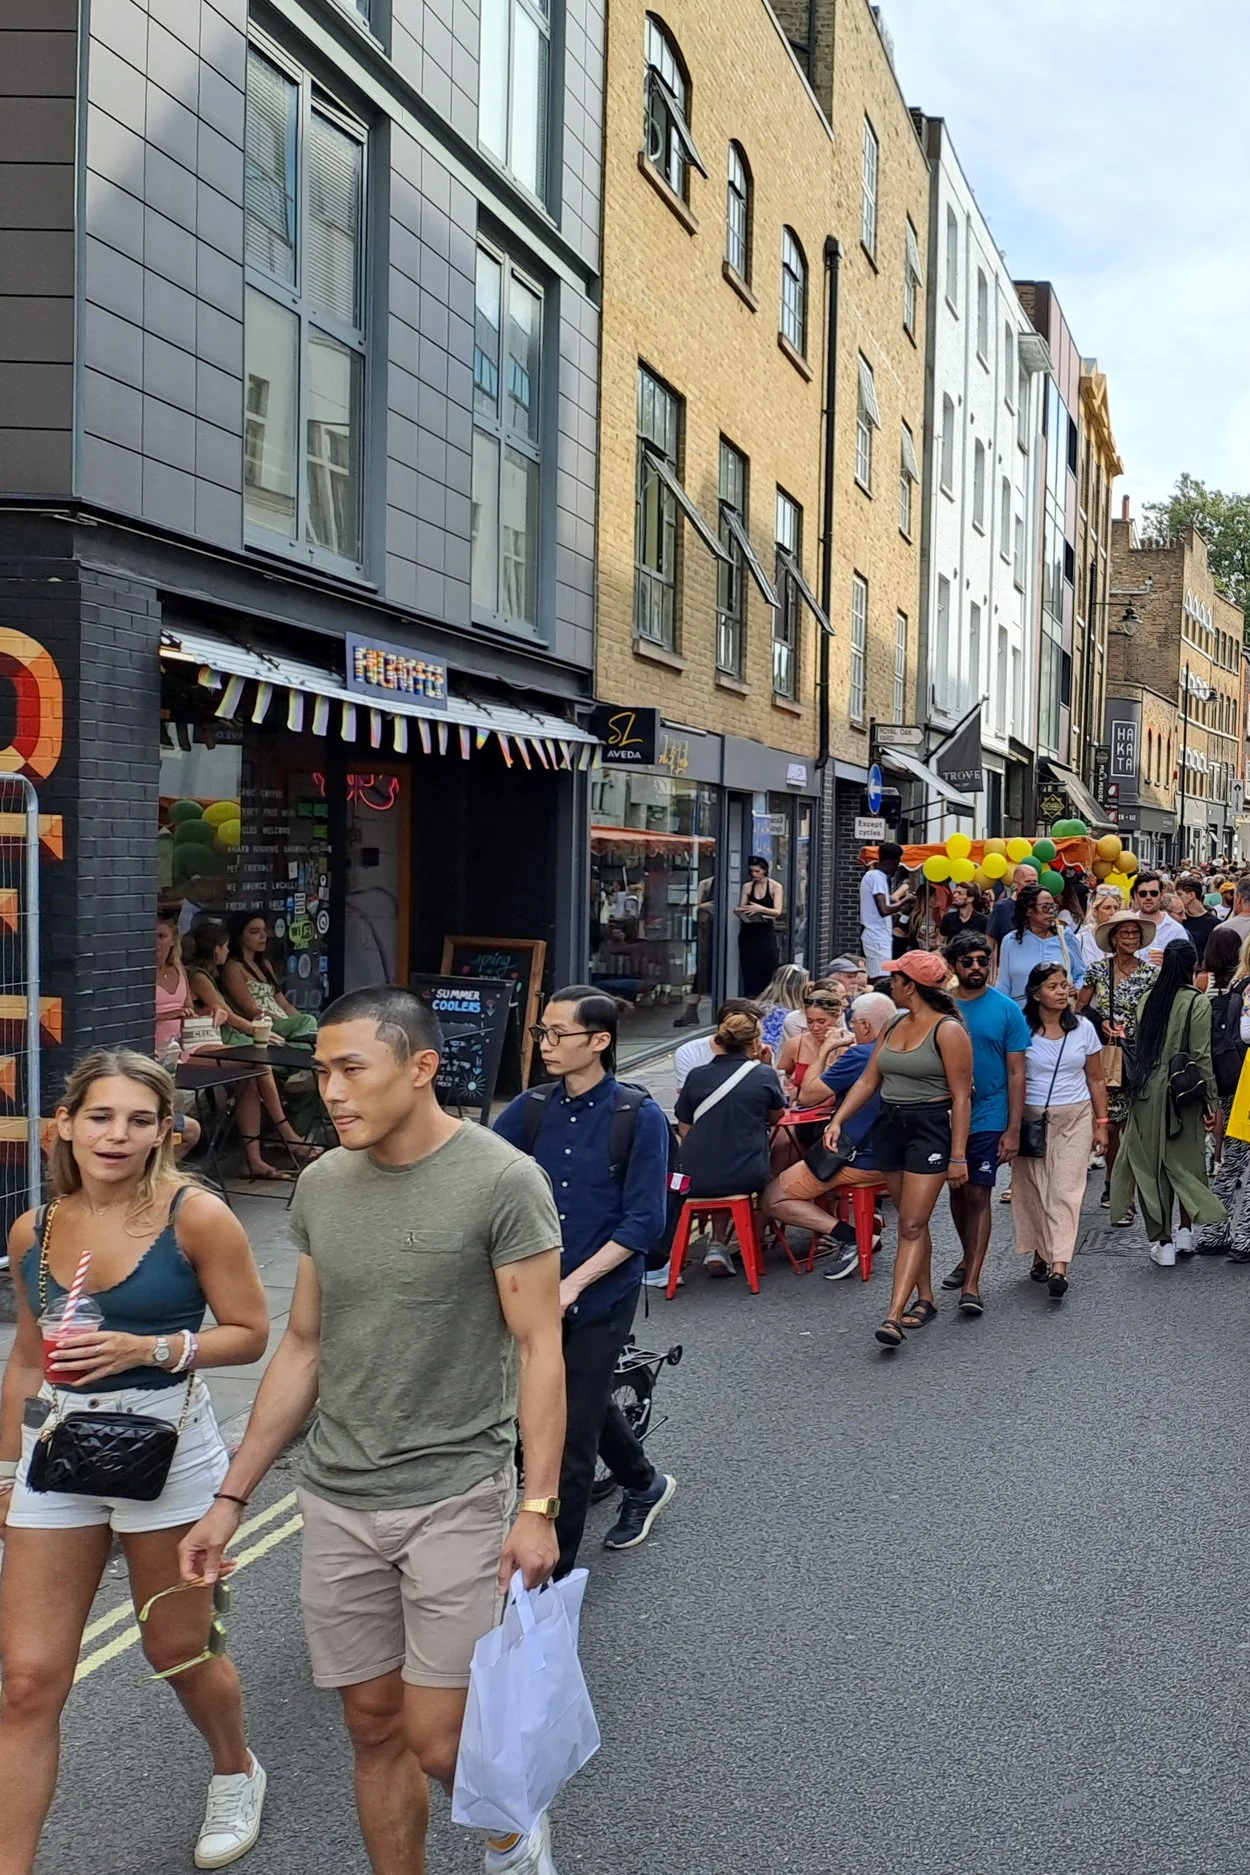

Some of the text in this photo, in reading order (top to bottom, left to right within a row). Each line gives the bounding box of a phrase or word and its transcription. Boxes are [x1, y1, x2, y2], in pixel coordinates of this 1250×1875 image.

[607, 750, 641, 759] AVEDA
[942, 770, 981, 781] TROVE
[858, 820, 882, 828] Except
[859, 829, 881, 837] cycles
[435, 988, 480, 1001] SUMMER
[432, 999, 481, 1013] COOLERS
